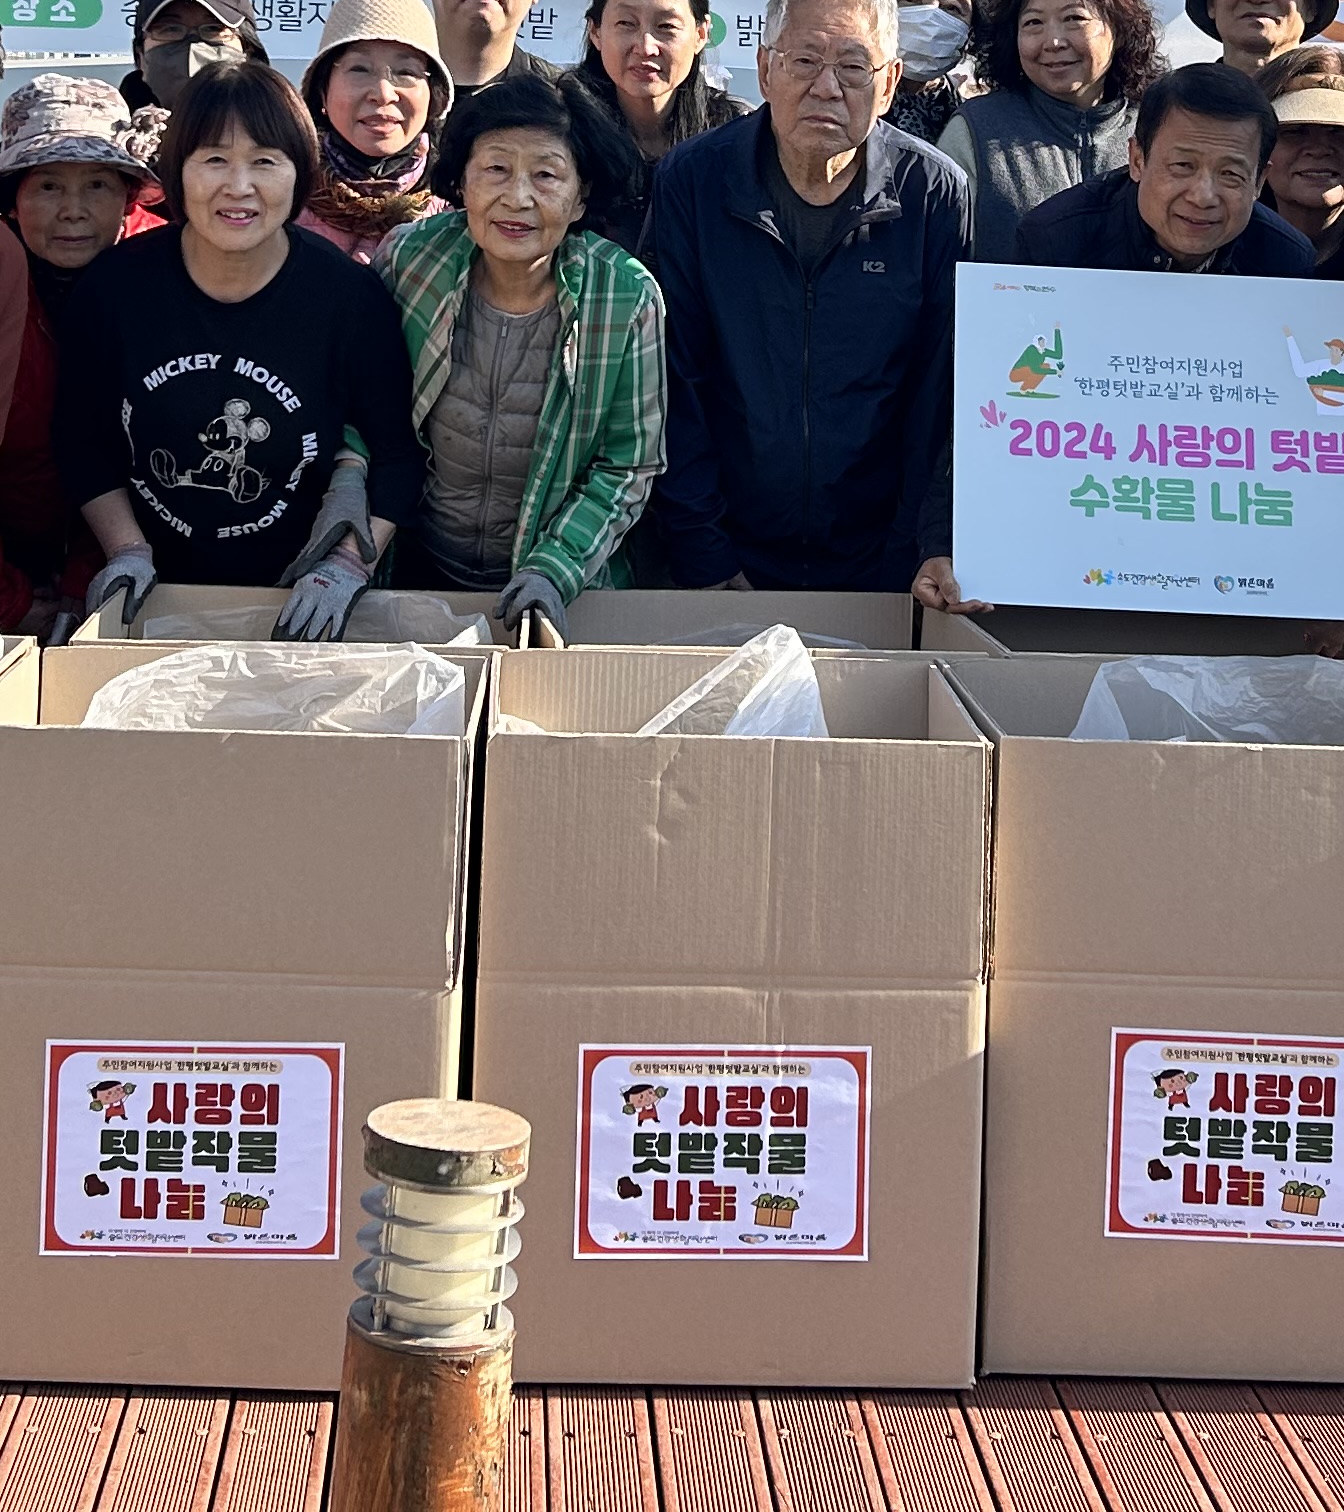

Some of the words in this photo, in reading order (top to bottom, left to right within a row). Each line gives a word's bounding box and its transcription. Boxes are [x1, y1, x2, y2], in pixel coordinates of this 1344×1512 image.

[863, 260, 886, 273] K2
[143, 353, 222, 391] MICKEY
[233, 357, 302, 413] MOUSE
[1107, 355, 1244, 378] 주민참여지원사업
[1209, 385, 1280, 405] 함께하는
[1008, 418, 1116, 461] 2024
[1128, 423, 1255, 470] 사랑의
[130, 478, 193, 538] MICKEY
[217, 500, 288, 538] MOUSE
[1069, 473, 1196, 522] 수확물
[1210, 481, 1294, 526] 나눔
[147, 1082, 280, 1126] 사랑의
[679, 1085, 809, 1128] 사랑의
[1209, 1072, 1337, 1117] 사랑의
[99, 1129, 278, 1174] 텃밭작물
[632, 1132, 807, 1175] 텃밭작물
[1162, 1116, 1334, 1163] 텃밭작물
